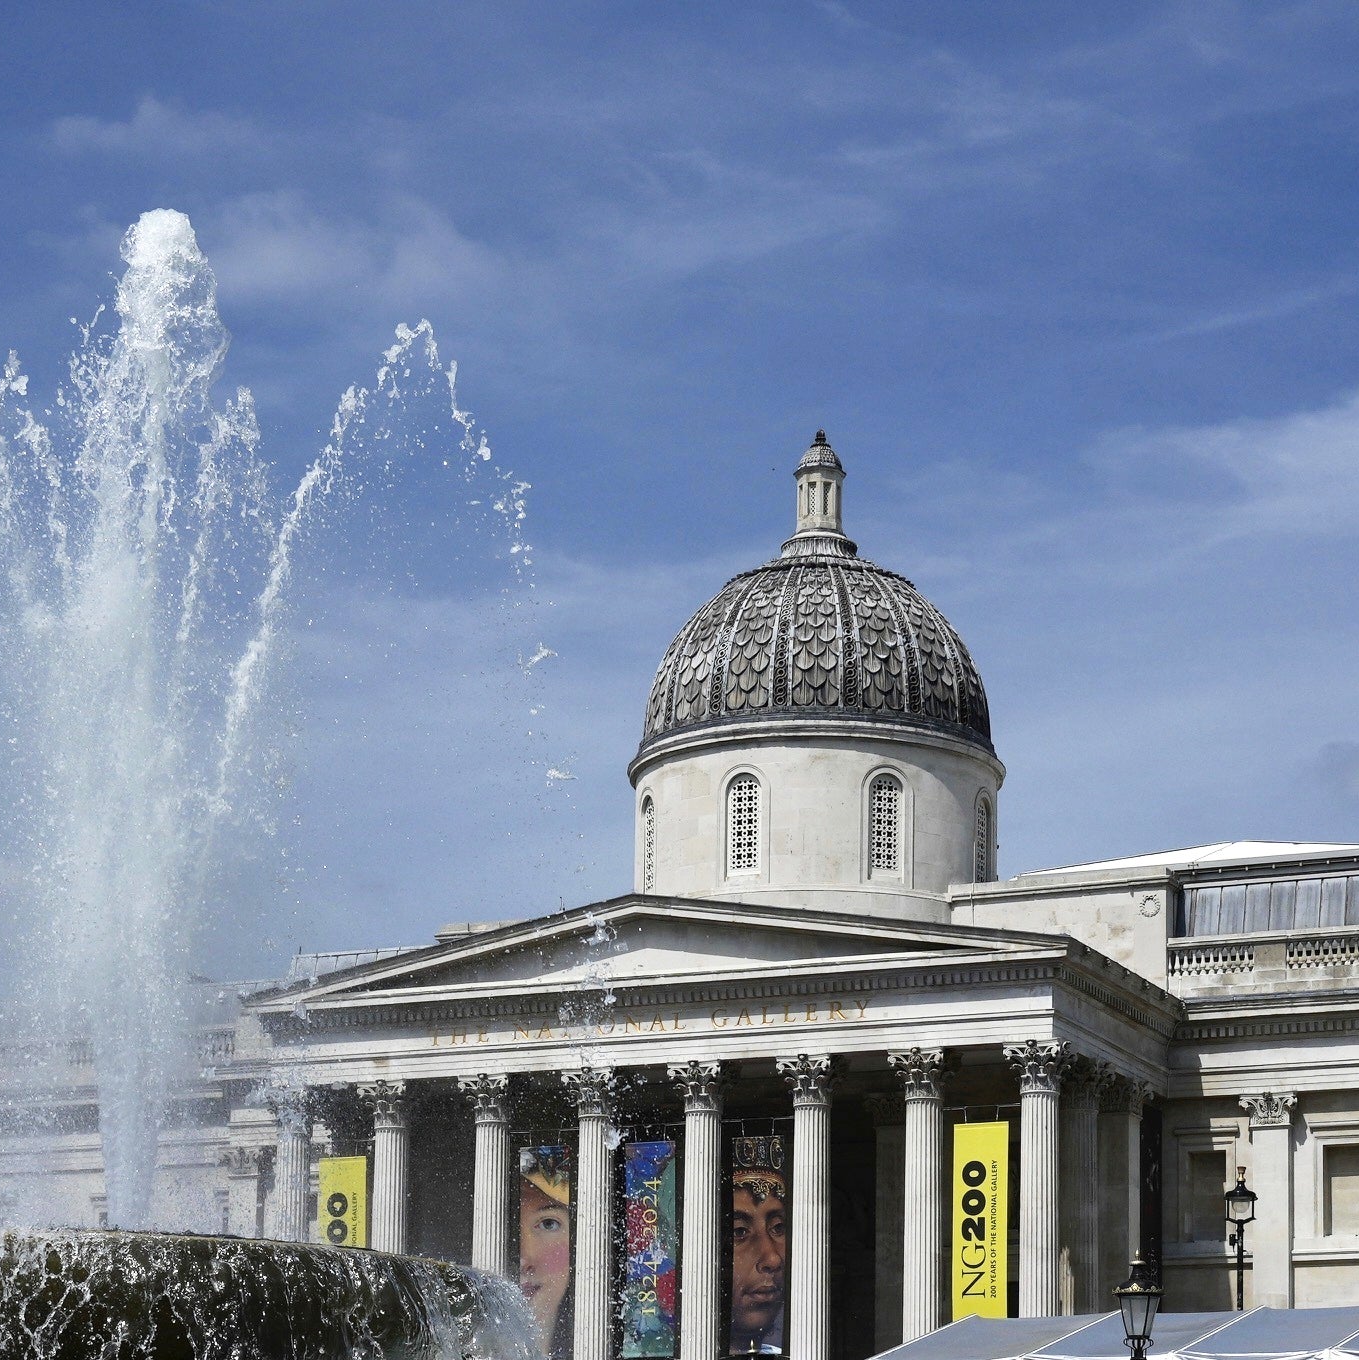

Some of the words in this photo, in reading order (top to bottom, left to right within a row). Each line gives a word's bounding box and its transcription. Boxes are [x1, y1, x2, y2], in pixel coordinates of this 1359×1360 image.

[430, 1026, 490, 1047] THE
[513, 1012, 687, 1040] NAONAL
[711, 999, 870, 1029] GALLERY
[642, 1176, 662, 1240] 2024
[961, 1160, 987, 1299] NG200
[991, 1246, 997, 1259] OF
